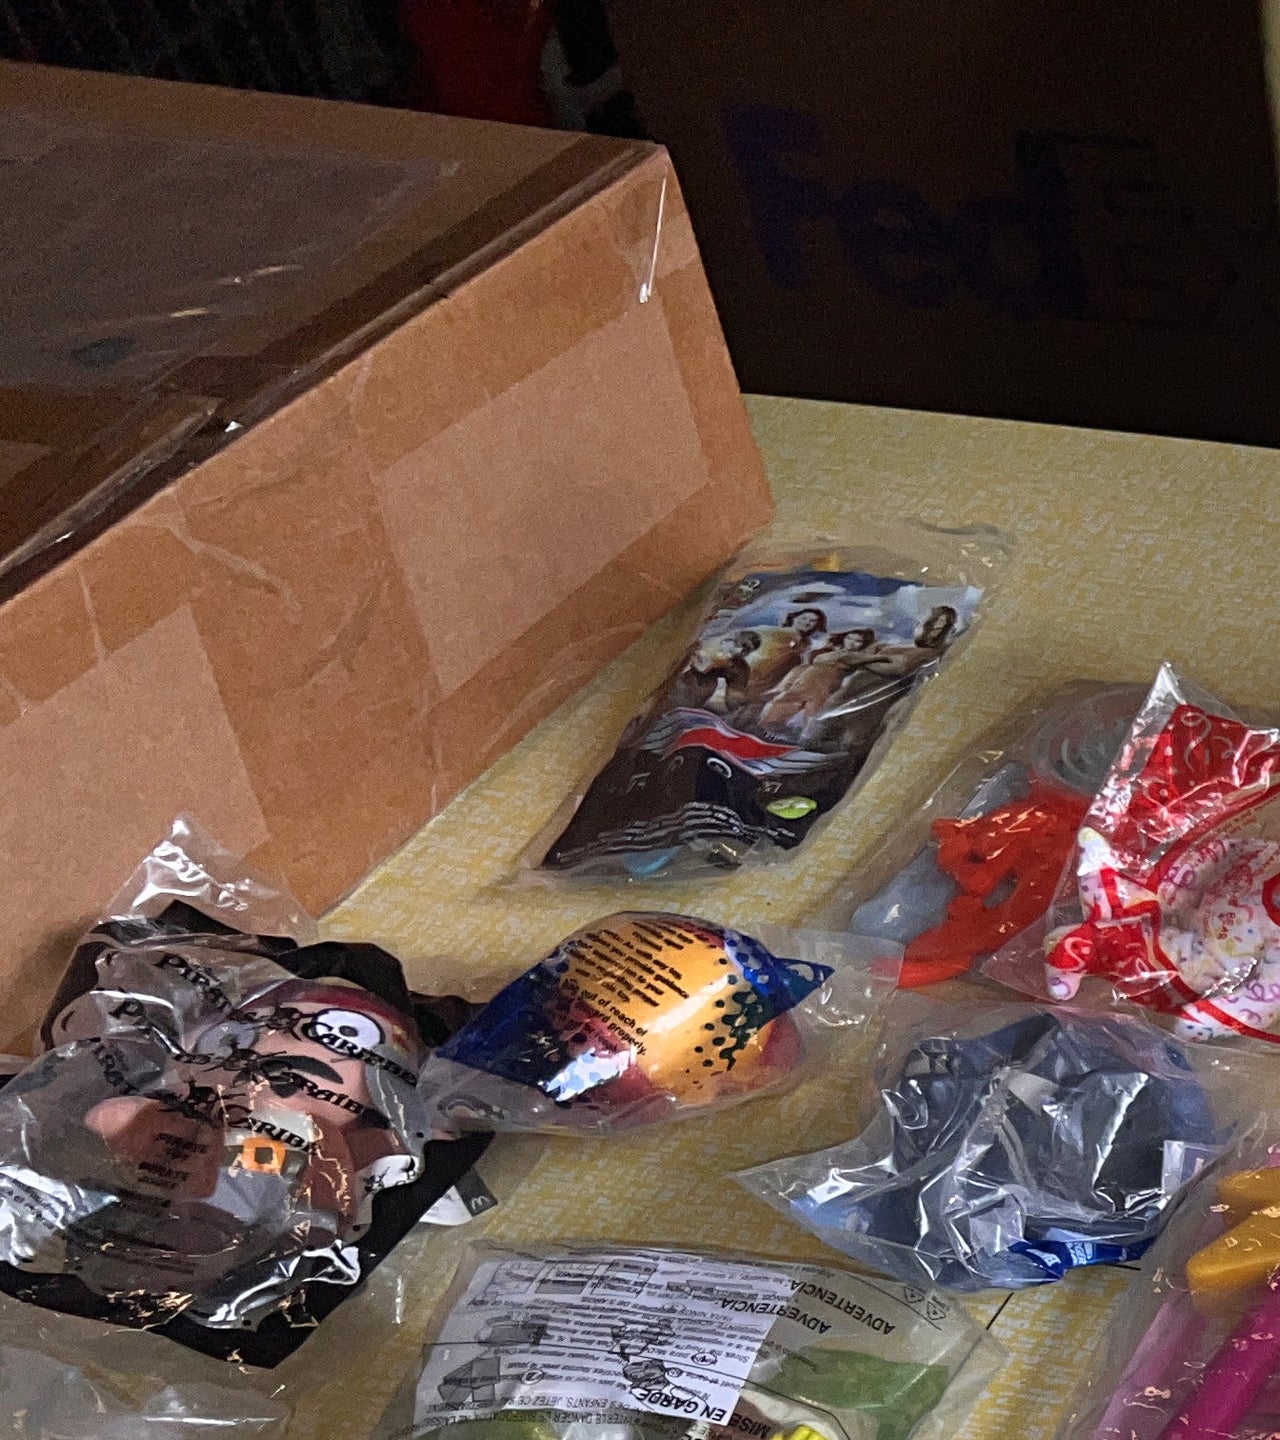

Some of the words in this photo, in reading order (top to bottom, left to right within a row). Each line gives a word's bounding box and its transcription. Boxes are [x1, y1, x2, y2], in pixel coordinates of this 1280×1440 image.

[596, 995, 612, 1009] of
[606, 1003, 638, 1030] reach
[634, 1024, 648, 1038] of
[607, 1021, 648, 1056] properly.
[716, 1296, 831, 1335] ADVERTENCIA:
[786, 1277, 894, 1335] ADVERTENCIA:
[634, 1386, 699, 1416] GARDE
[699, 1403, 727, 1423] EN
